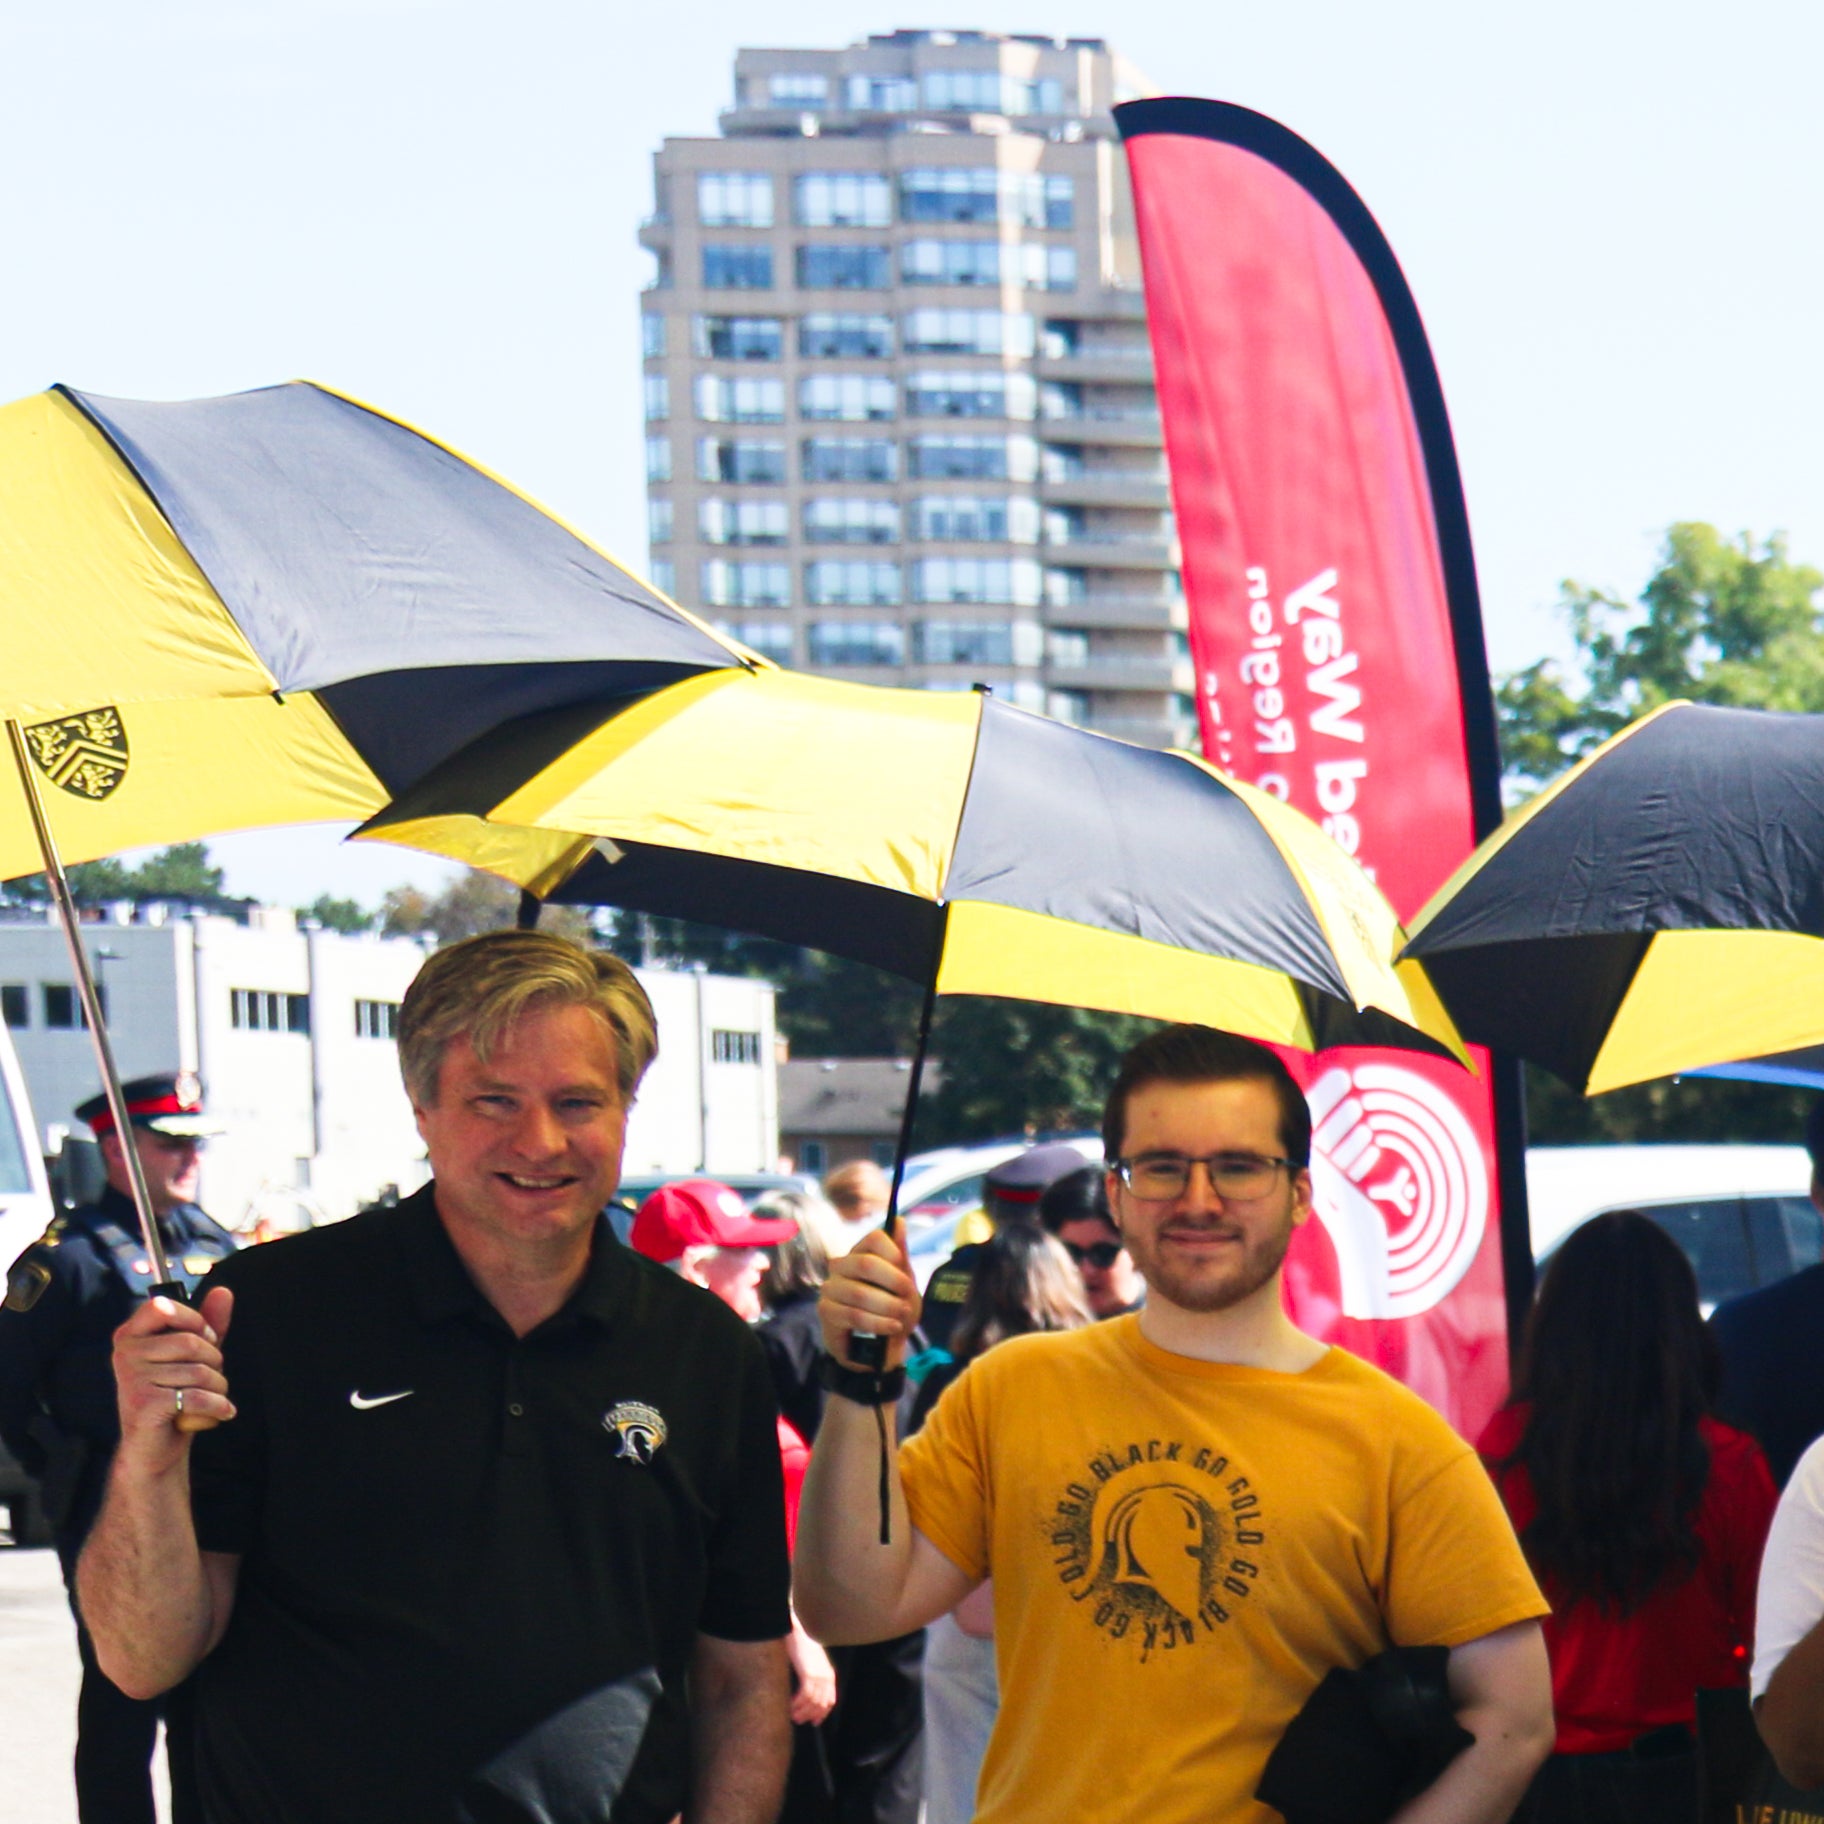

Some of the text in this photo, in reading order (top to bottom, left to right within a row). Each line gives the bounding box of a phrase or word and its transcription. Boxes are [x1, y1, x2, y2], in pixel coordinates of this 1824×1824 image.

[1089, 1440, 1182, 1483] BLACK
[1193, 1448, 1229, 1477] GO
[1057, 1483, 1092, 1517] GO
[1226, 1477, 1264, 1546] GOLD
[1223, 1559, 1259, 1598] GO
[1093, 1602, 1131, 1638] GO
